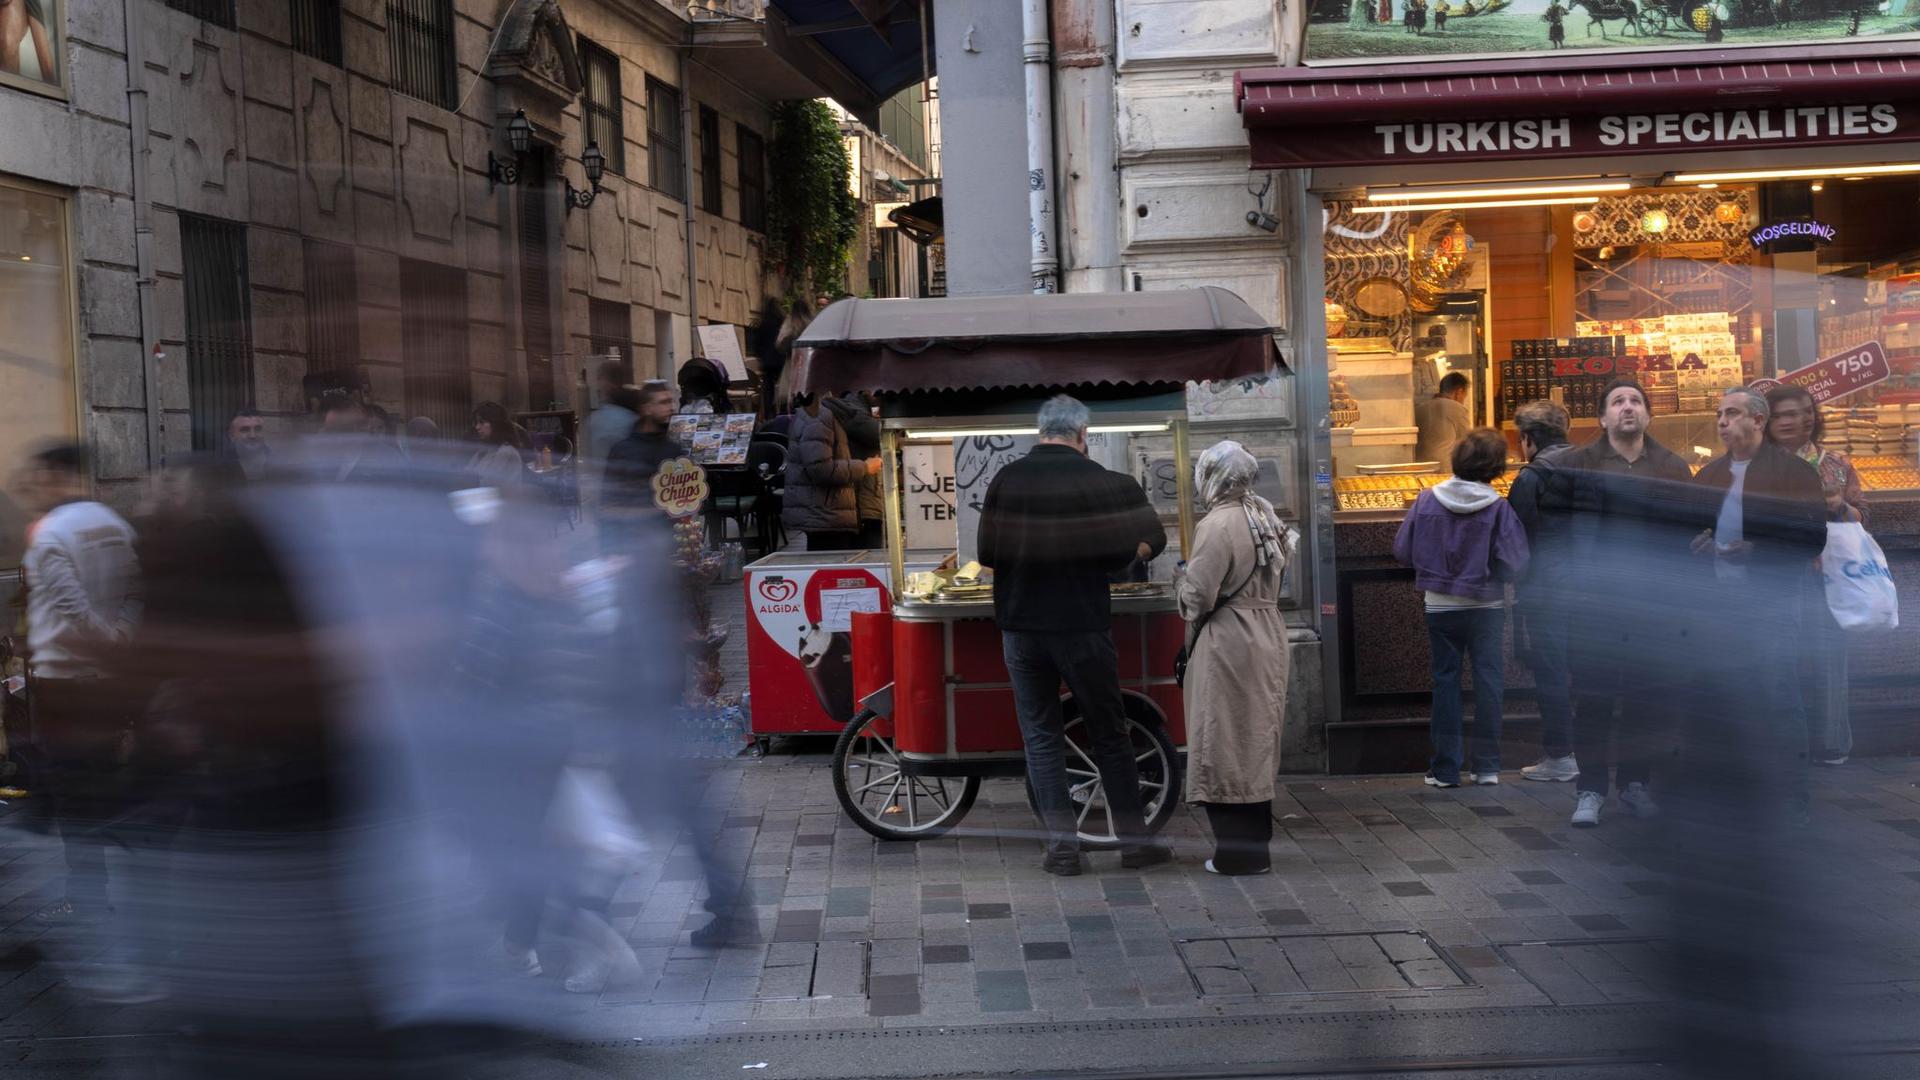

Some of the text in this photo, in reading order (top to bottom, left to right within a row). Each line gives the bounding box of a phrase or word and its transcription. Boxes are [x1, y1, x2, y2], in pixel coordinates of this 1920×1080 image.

[1375, 104, 1898, 154] TURKISH SPECIALITIES
[1553, 352, 1709, 377] KOSKA
[1835, 351, 1873, 376] 750
[1807, 378, 1837, 395] ECIAL
[659, 470, 699, 487] Chupa
[660, 484, 700, 503] Chups
